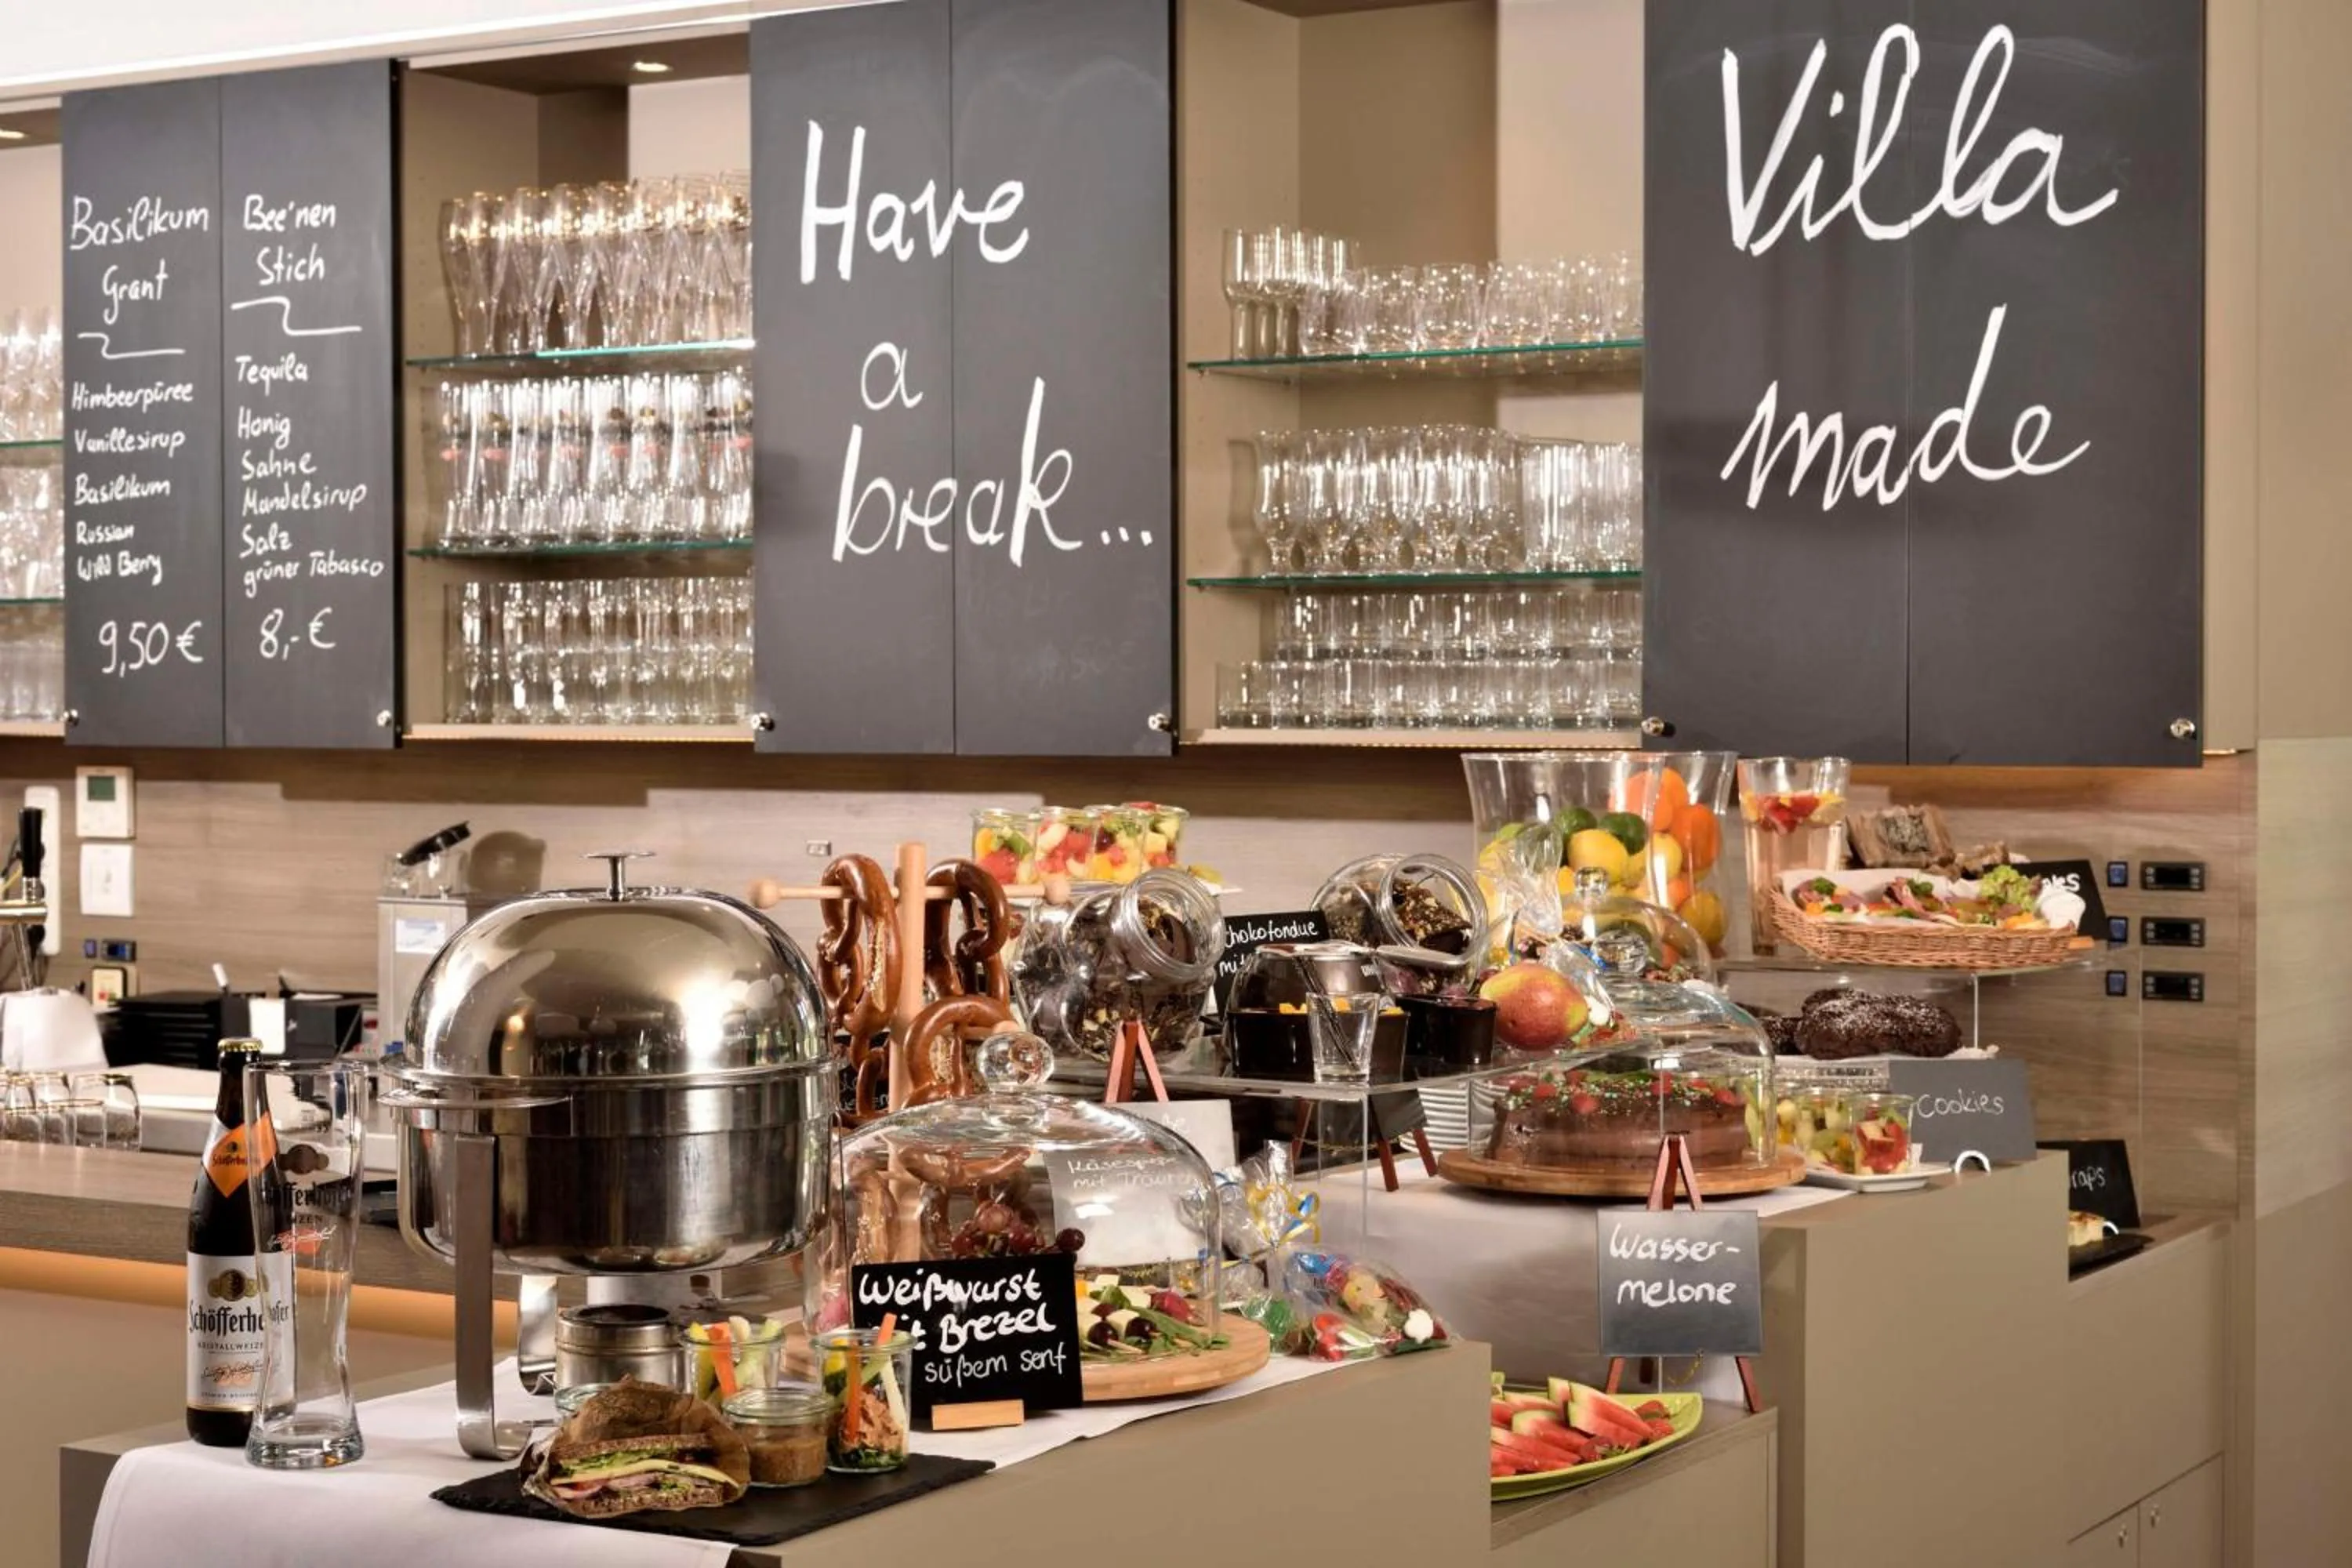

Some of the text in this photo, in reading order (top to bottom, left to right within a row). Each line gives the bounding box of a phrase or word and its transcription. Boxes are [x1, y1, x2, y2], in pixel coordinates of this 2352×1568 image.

[1721, 24, 2119, 257] Villa
[70, 195, 209, 250] Basilikum
[800, 119, 1030, 285] Have
[256, 243, 325, 285] Stich
[102, 259, 168, 325] Grant
[234, 352, 308, 395] Tequila
[861, 341, 924, 412] a
[72, 381, 194, 414] Himbeerpüree
[74, 427, 186, 459] Vanillesirup
[238, 406, 291, 449] Honig
[241, 448, 318, 481] Sahne
[74, 473, 171, 506] Basilikum
[241, 481, 368, 517] Mandelsirup
[76, 521, 136, 545] Russian
[239, 522, 293, 559] Salz
[244, 549, 384, 599] grüner Tabasco
[98, 620, 204, 677] 9,50 €
[309, 607, 336, 648] €
[1917, 1088, 2004, 1118] Cookies
[1610, 1223, 1740, 1263] Wasser-
[858, 1268, 1043, 1312] Weißwurst
[938, 1302, 1057, 1354] Brezel
[924, 1354, 1007, 1388] süßem
